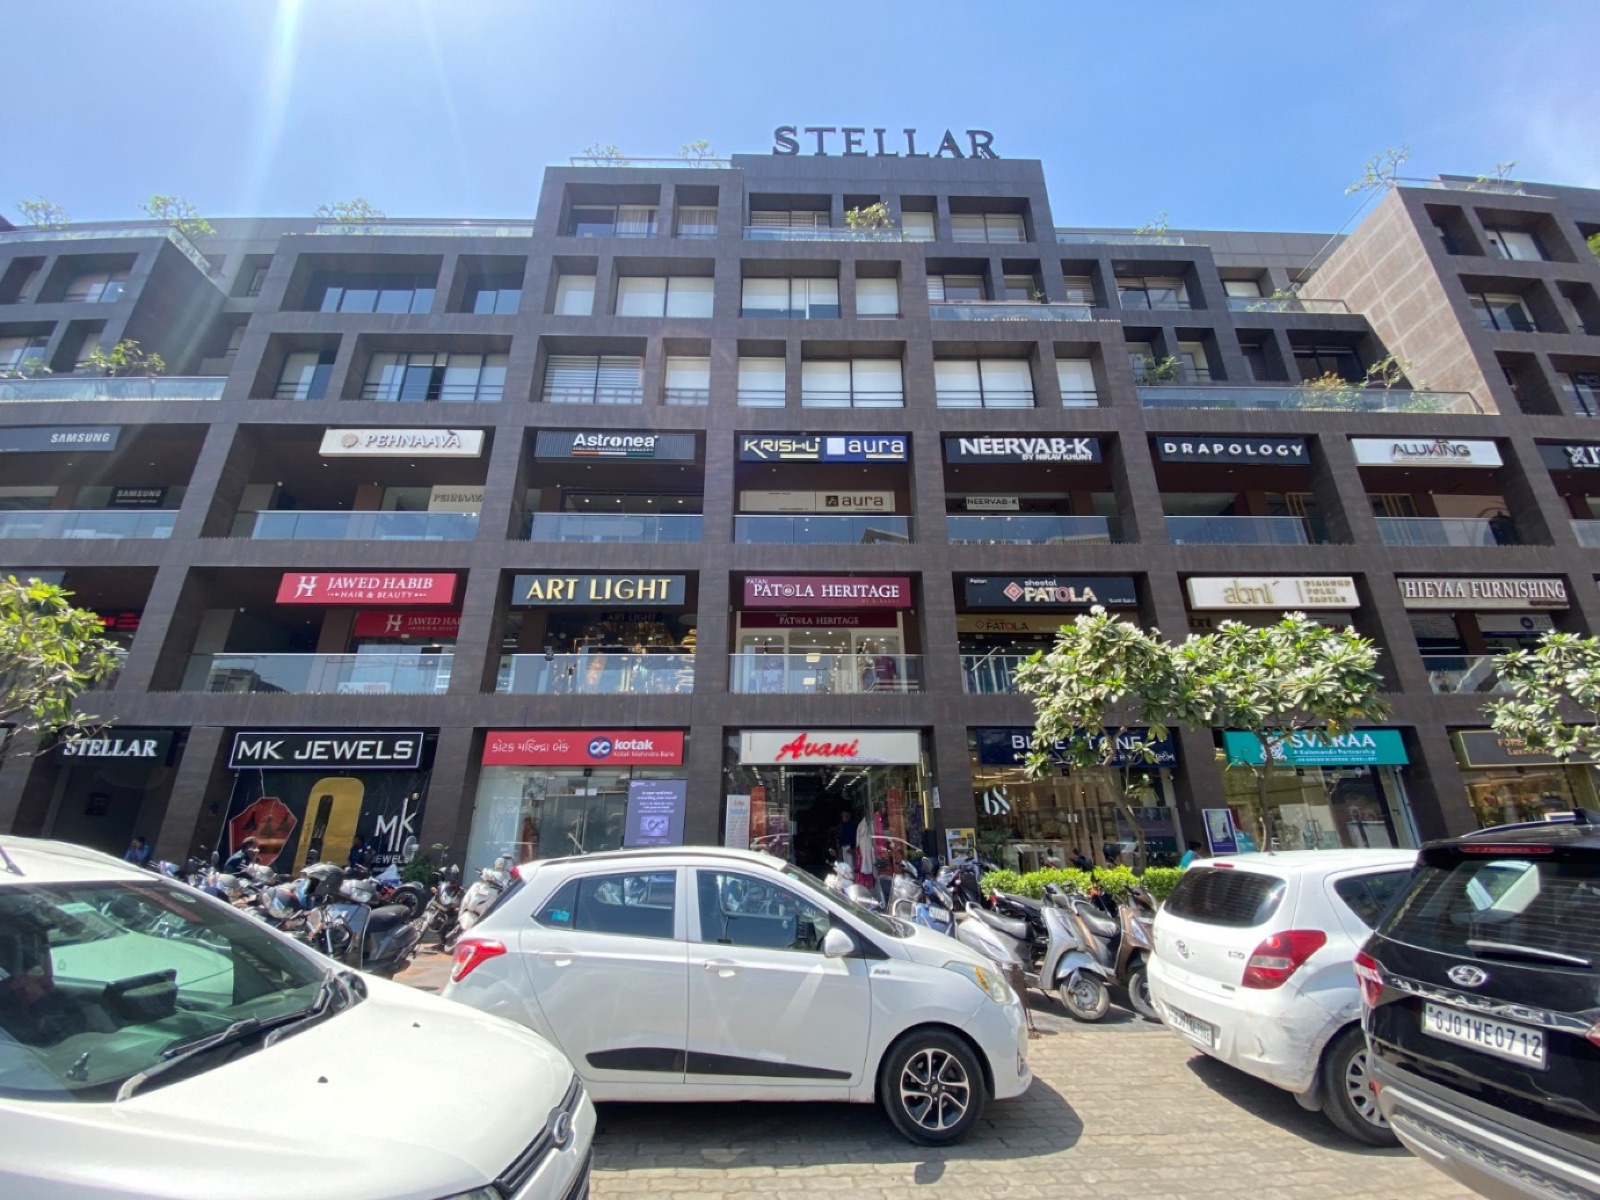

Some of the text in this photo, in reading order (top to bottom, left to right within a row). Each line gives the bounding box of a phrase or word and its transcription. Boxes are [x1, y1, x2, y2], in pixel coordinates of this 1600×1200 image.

[772, 125, 1001, 159] STELLAR
[51, 433, 111, 443] SAMSUNG
[364, 434, 461, 449] PEHNAAVA
[573, 433, 655, 447] Astronea
[848, 440, 904, 453] aura
[959, 438, 1093, 455] NEERVAB-K
[1163, 443, 1303, 457] DRAPOLOGY
[1391, 442, 1471, 457] ALUKING
[117, 490, 162, 498] SAMSUNG
[842, 496, 884, 507] aura
[327, 577, 434, 589] JAWED HABIB
[526, 579, 671, 600] ART LIGHT
[1405, 581, 1566, 598] HIEYAA FURNISHING
[377, 591, 413, 599] BEAUTY
[754, 584, 900, 598] PATOLA HERITAGE
[1024, 587, 1098, 602] PATOLA
[408, 616, 441, 626] JAWED
[816, 617, 859, 625] HERITAGE
[63, 739, 158, 757] STELLAR
[614, 739, 653, 750] kotak
[775, 732, 859, 761] Avani
[1292, 733, 1377, 749] SVRAA
[237, 741, 414, 760] MK JEWELS
